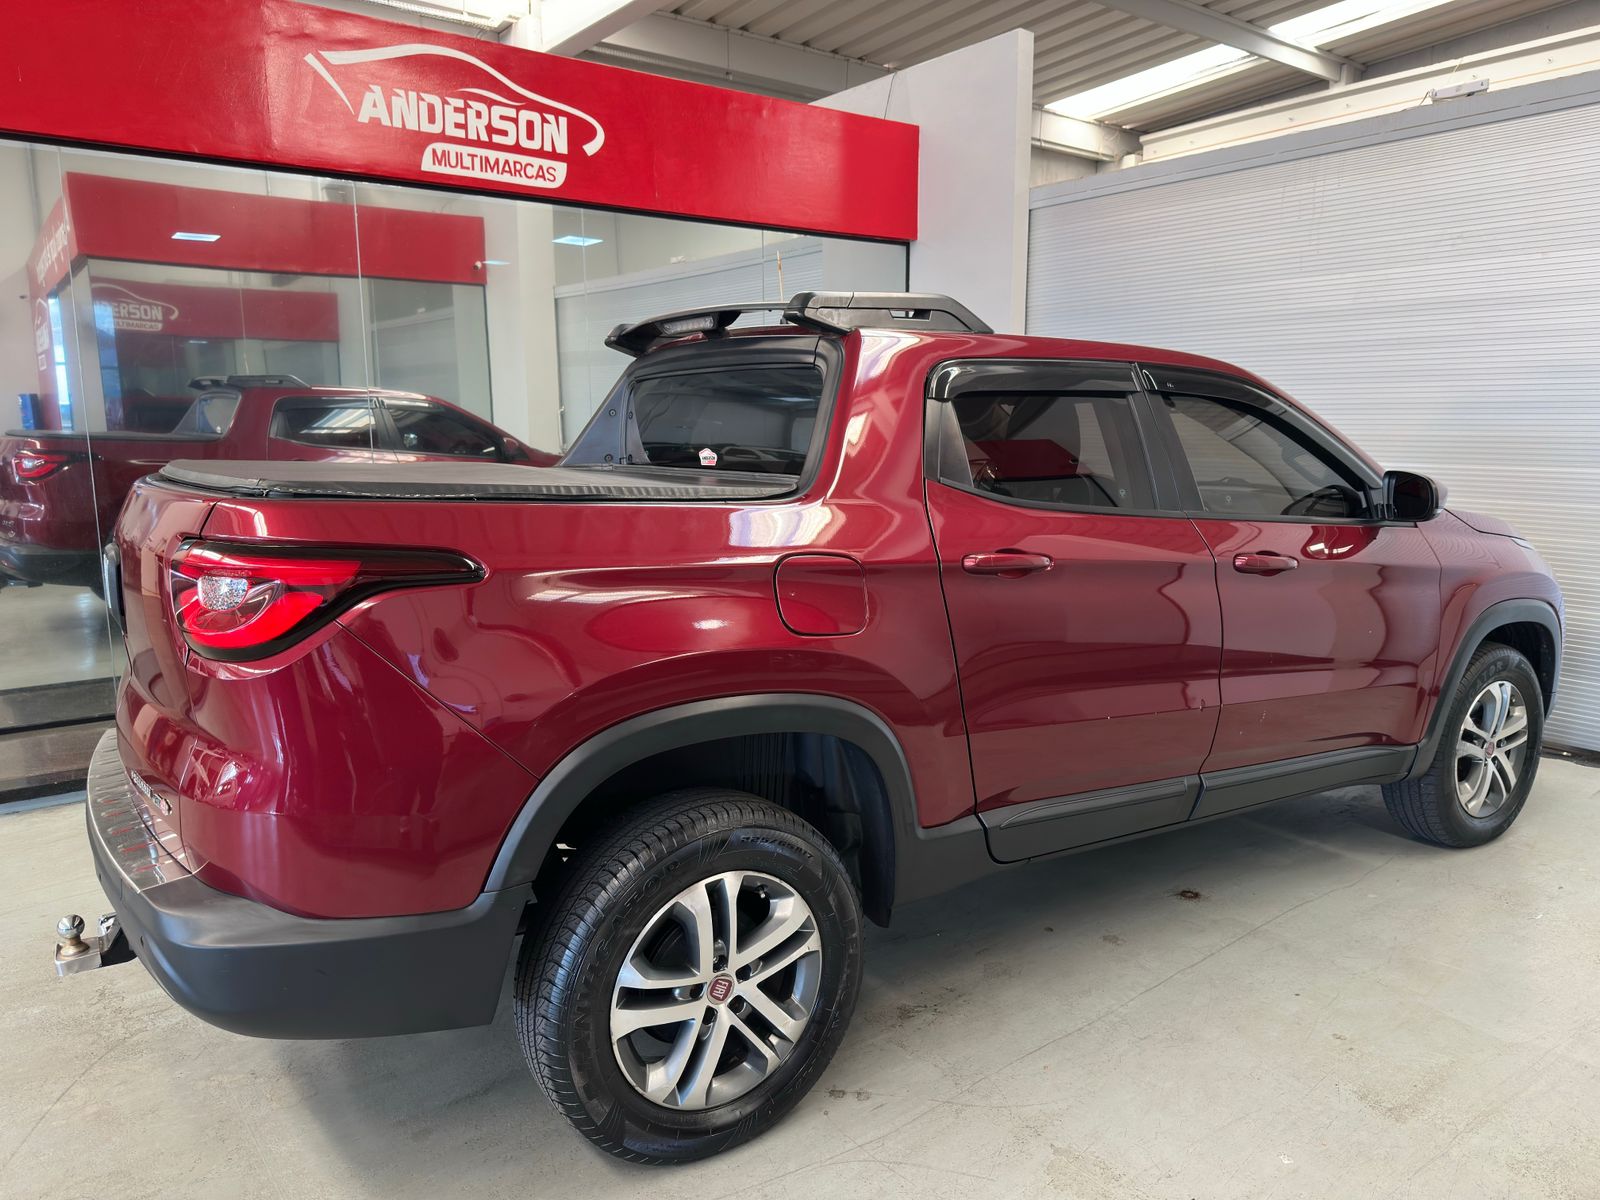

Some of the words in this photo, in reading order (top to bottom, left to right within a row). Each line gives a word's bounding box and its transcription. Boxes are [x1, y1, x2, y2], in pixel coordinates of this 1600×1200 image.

[357, 84, 568, 154] ANDERSON
[431, 147, 557, 183] MULTIMARCAS
[712, 979, 730, 999] FIAT
